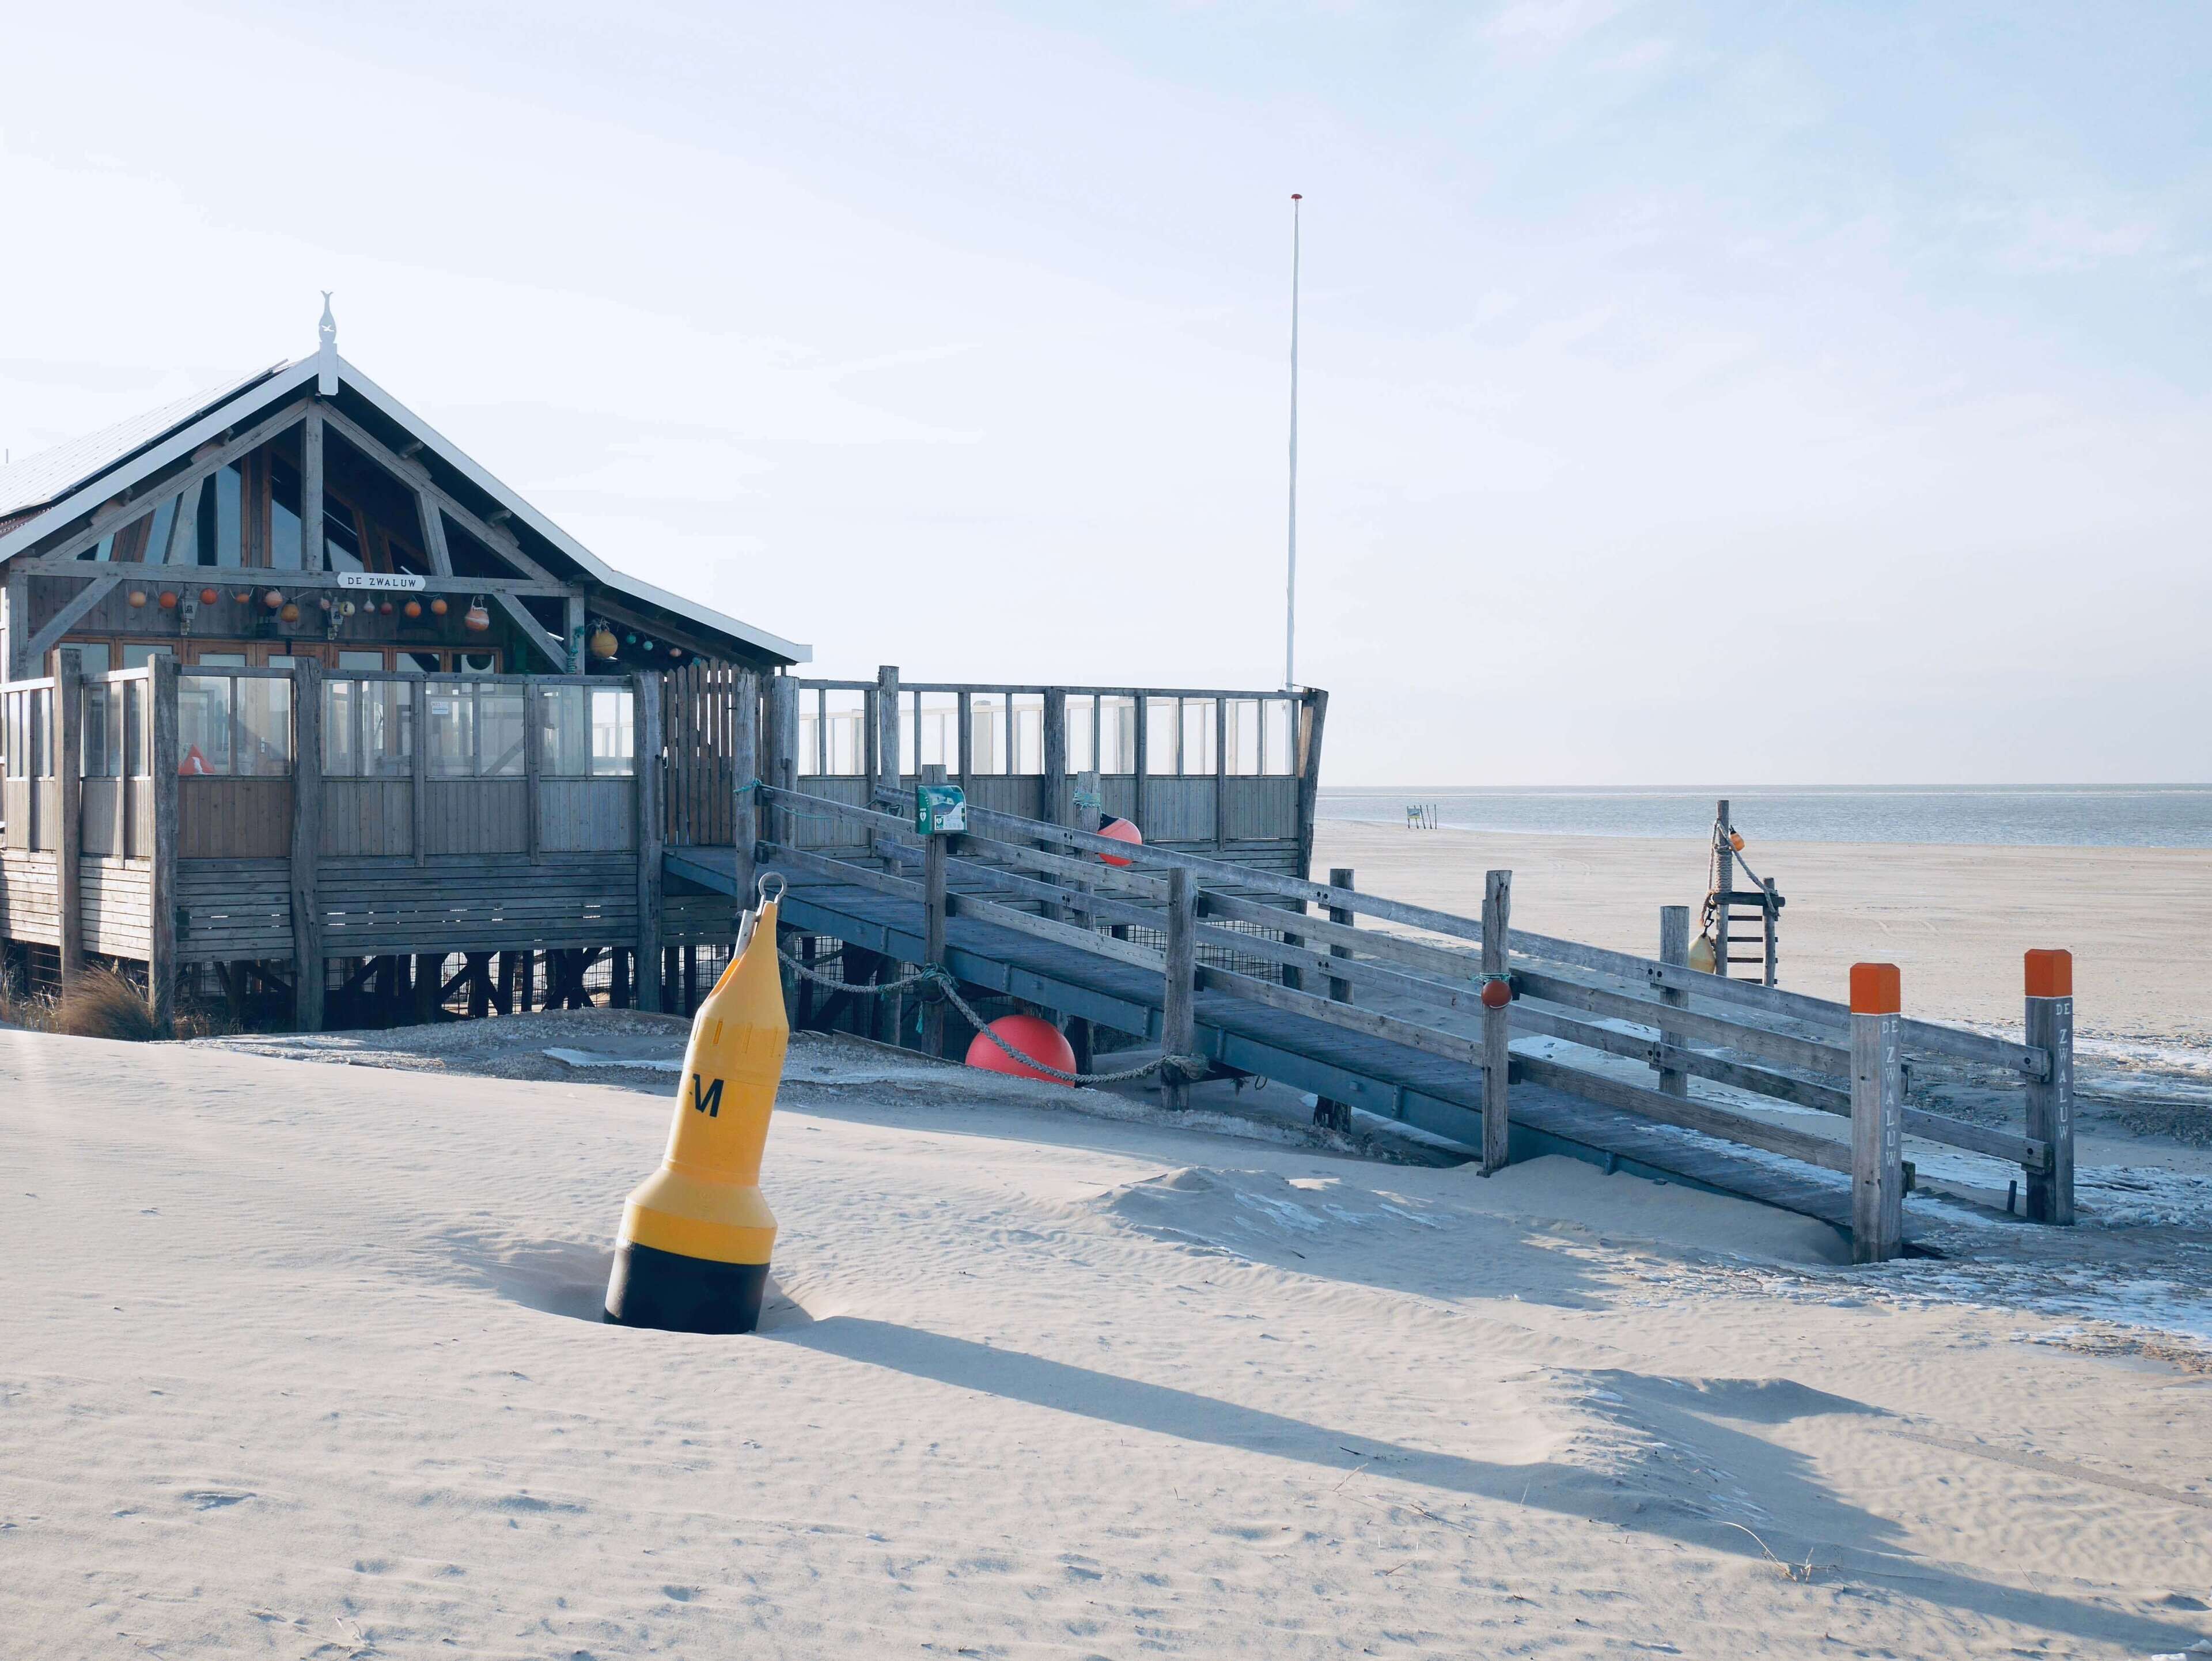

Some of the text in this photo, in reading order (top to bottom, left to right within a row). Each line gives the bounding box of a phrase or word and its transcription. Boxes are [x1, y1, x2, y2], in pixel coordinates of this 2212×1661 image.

[369, 578, 416, 587] ZWALUW
[2055, 1002, 2070, 1016] DE
[1882, 1020, 1899, 1034] DE
[2058, 1028, 2069, 1141] ZWALUW
[1885, 1046, 1896, 1167] ZWALUW
